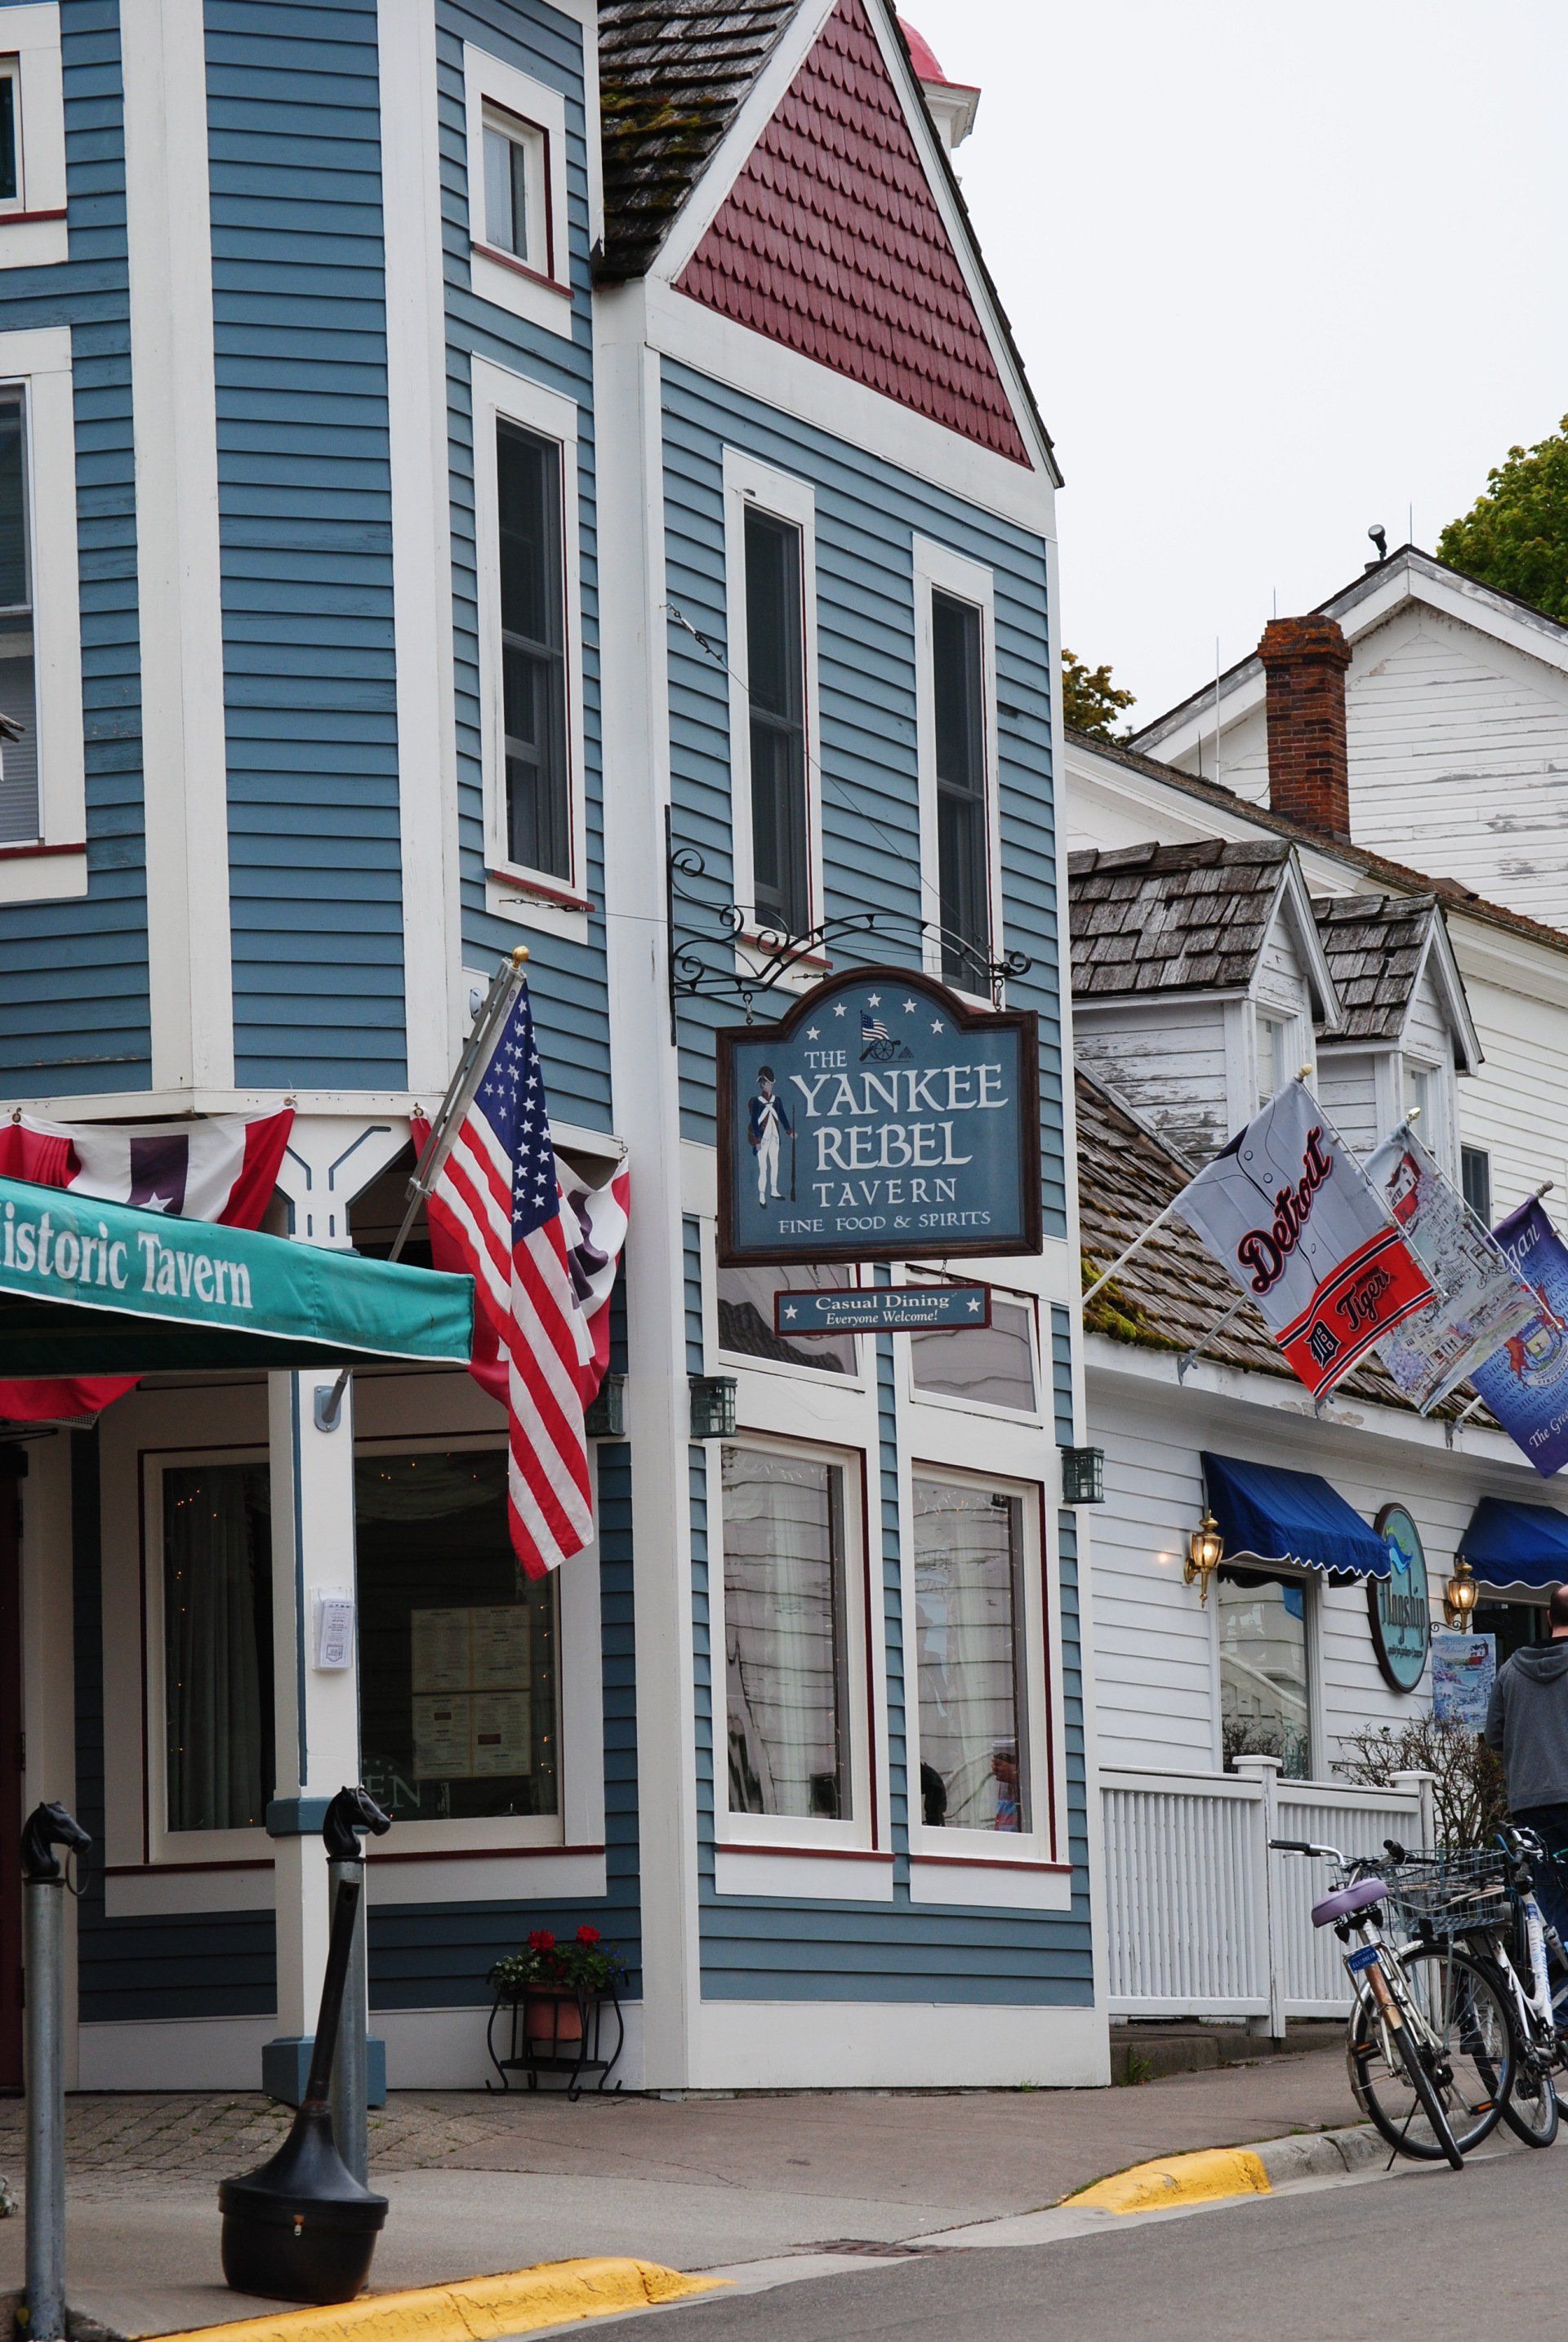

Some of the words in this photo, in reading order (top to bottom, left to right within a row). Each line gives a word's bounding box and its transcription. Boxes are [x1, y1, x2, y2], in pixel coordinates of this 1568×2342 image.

[804, 1050, 847, 1070] THE
[789, 1063, 1009, 1118] YANKEE
[812, 1120, 973, 1171] REBEL
[812, 1178, 957, 1208] TAVERN
[1238, 1125, 1331, 1294] Detroit
[778, 1218, 825, 1234] FINE
[835, 1216, 886, 1231] FOOD
[893, 1215, 911, 1229] &
[918, 1211, 991, 1228] SPIRITS
[0, 1201, 128, 1289] istoric
[137, 1231, 253, 1308] Tavern
[815, 1295, 878, 1310] Casual
[884, 1294, 949, 1308] Dining
[1335, 1266, 1391, 1332] Tigers
[826, 1312, 879, 1326] Everyone
[882, 1309, 938, 1323] Welcome!
[1529, 1428, 1550, 1448] The
[362, 1774, 421, 1810] EN
